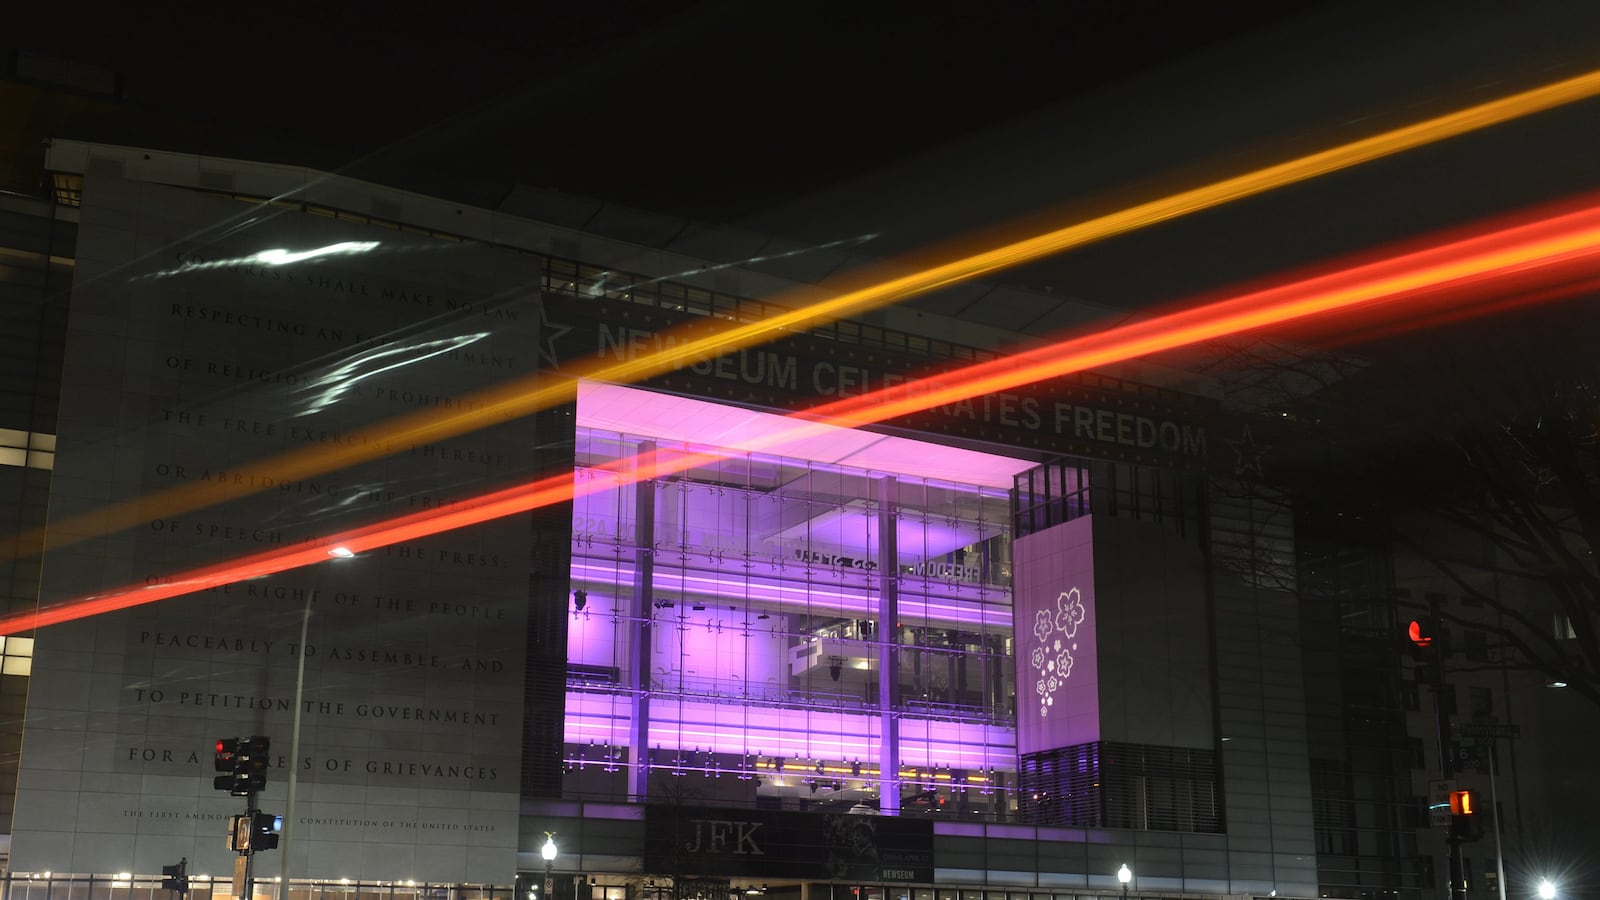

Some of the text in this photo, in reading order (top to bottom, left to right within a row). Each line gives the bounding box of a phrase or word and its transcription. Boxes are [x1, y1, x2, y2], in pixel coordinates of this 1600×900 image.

[305, 273, 369, 296] SHALL
[381, 288, 433, 307] MAKE
[447, 299, 473, 314] NO
[483, 304, 520, 321] LAW
[170, 303, 305, 336] RESPECTING
[316, 327, 343, 342] AN
[166, 355, 192, 370] OF
[597, 322, 797, 391] NEWSEUM
[1055, 402, 1208, 456] FREEDOM
[161, 408, 209, 427] THE
[223, 418, 277, 437] FREE
[155, 463, 187, 481] OR
[200, 468, 339, 498] ABRIDGING
[150, 519, 181, 533] OF
[247, 583, 321, 603] RIGHT
[334, 592, 361, 608] OF
[375, 595, 416, 612] THE
[429, 601, 506, 621] PEOPLE
[140, 631, 273, 655] PEACEABLY
[287, 642, 316, 657] TO
[461, 658, 504, 673] AND
[134, 689, 498, 726] TO PETITION THE GOVERNMENT
[128, 747, 174, 763] FOR
[186, 752, 201, 765] A
[325, 757, 353, 773] OF
[365, 760, 497, 781] GRIEVANCES
[300, 816, 378, 828] CONSTITUTION
[421, 822, 459, 832] UNITED
[684, 818, 765, 856] JFK
[882, 869, 915, 880] NEWSEUM
